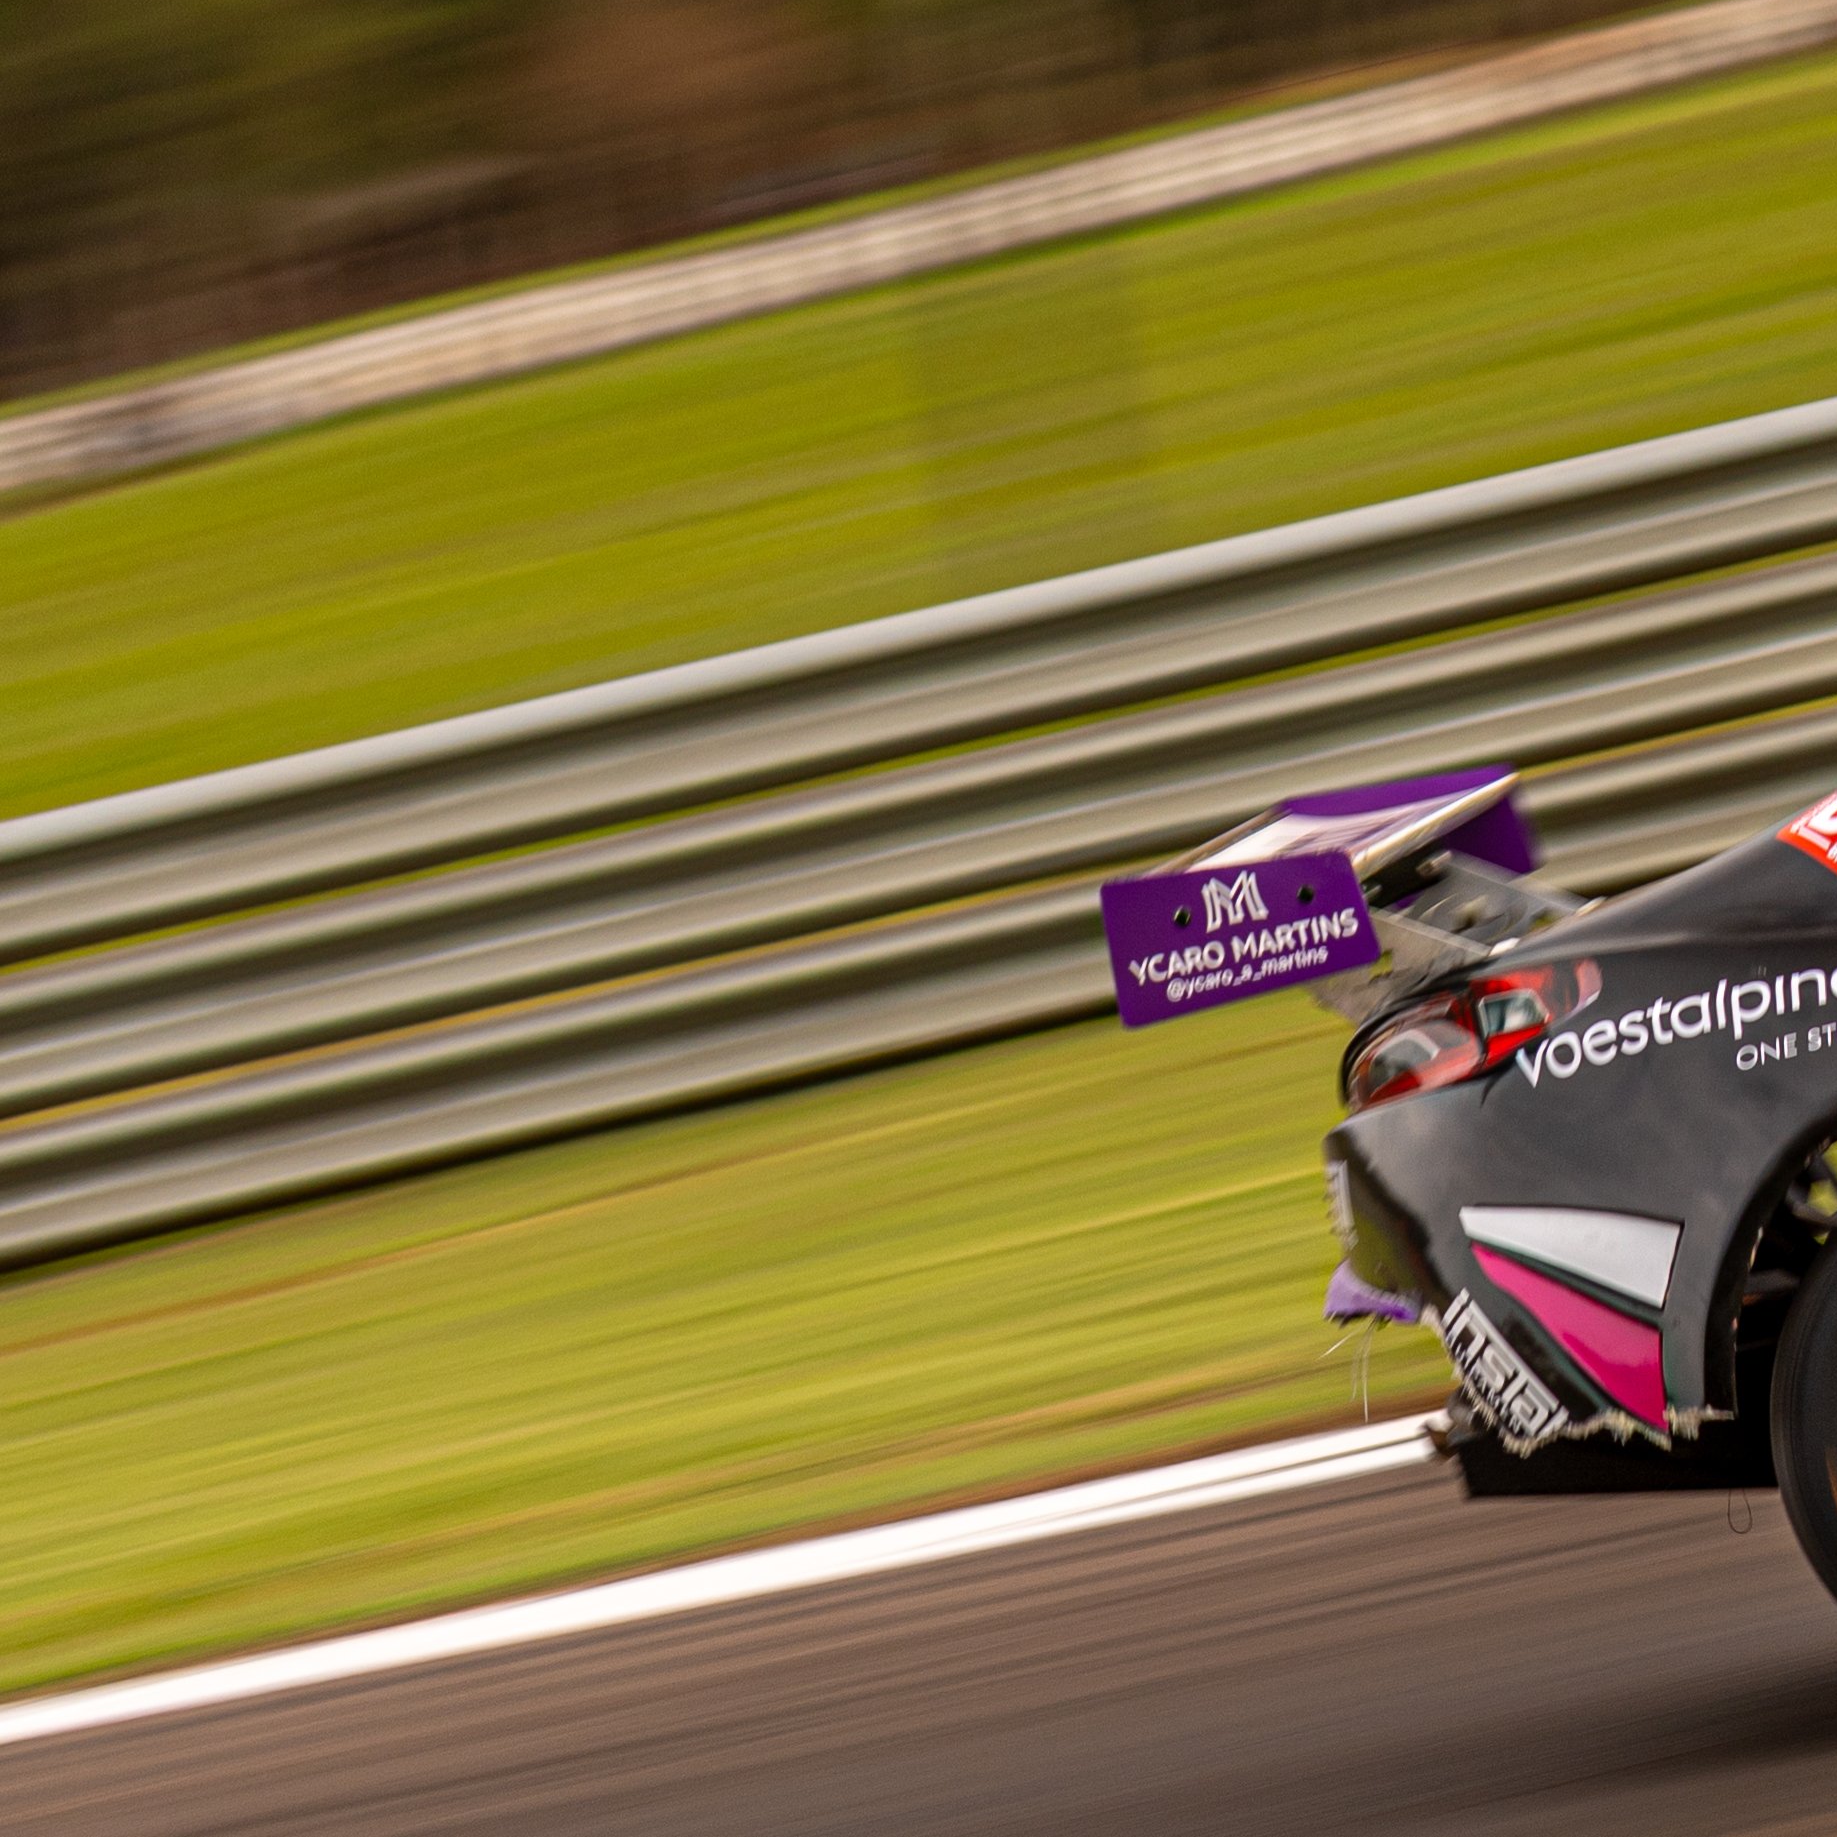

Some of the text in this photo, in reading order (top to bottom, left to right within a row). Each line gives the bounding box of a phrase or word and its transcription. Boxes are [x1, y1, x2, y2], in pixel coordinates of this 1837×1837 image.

[1128, 907, 1360, 987] YCARO MARTINS
[1166, 945, 1330, 1003] @ycaro_a_martins
[1736, 1032, 1798, 1072] ONE
